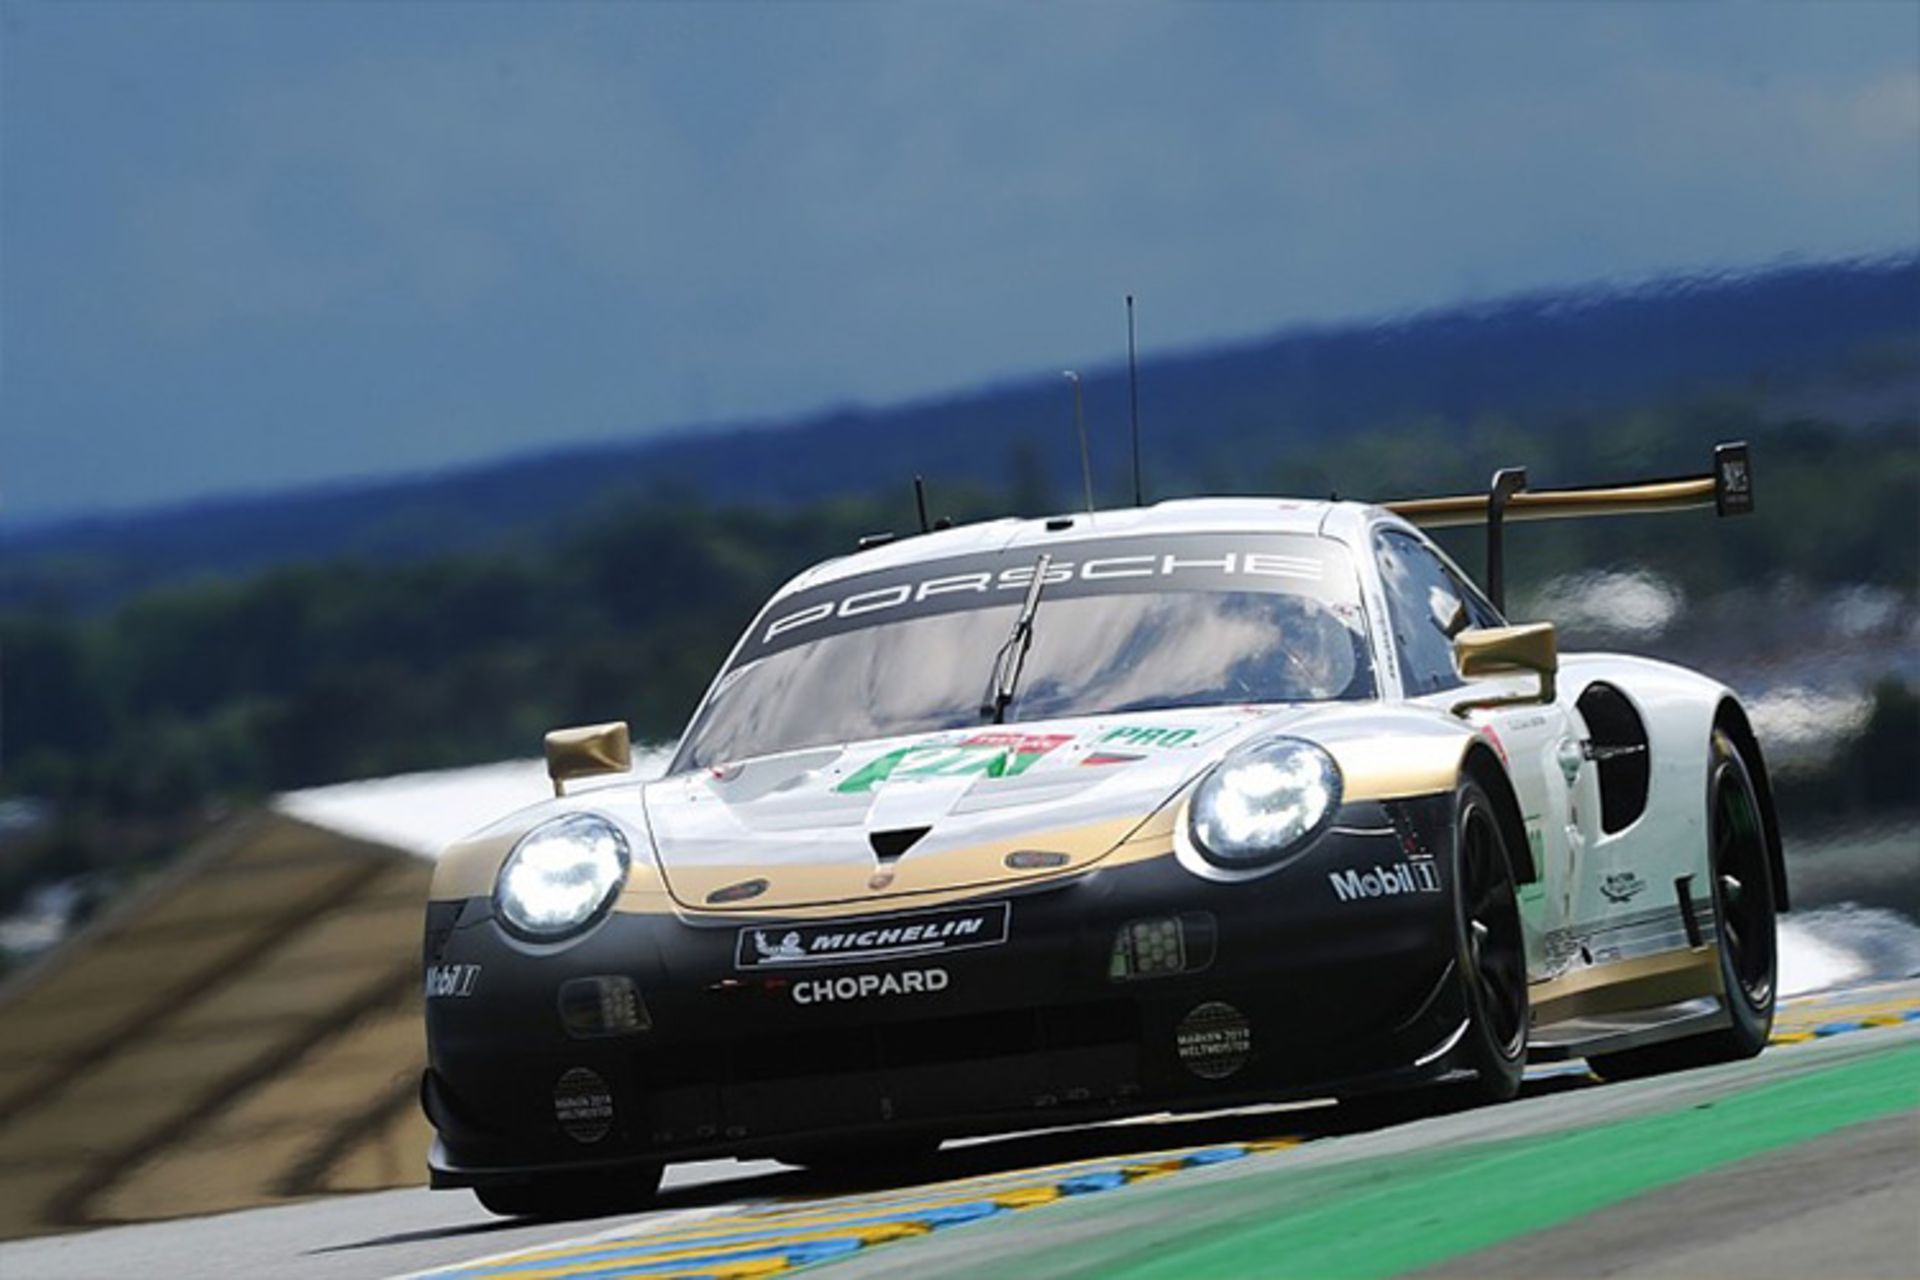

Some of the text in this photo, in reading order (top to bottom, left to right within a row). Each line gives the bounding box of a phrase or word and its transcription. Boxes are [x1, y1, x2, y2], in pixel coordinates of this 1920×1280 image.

[763, 553, 1324, 643] PORSCHE
[1101, 726, 1196, 748] PRO
[1328, 862, 1416, 901] Mobil
[811, 918, 984, 950] MICHELIN
[793, 969, 949, 1004] CHOPARD
